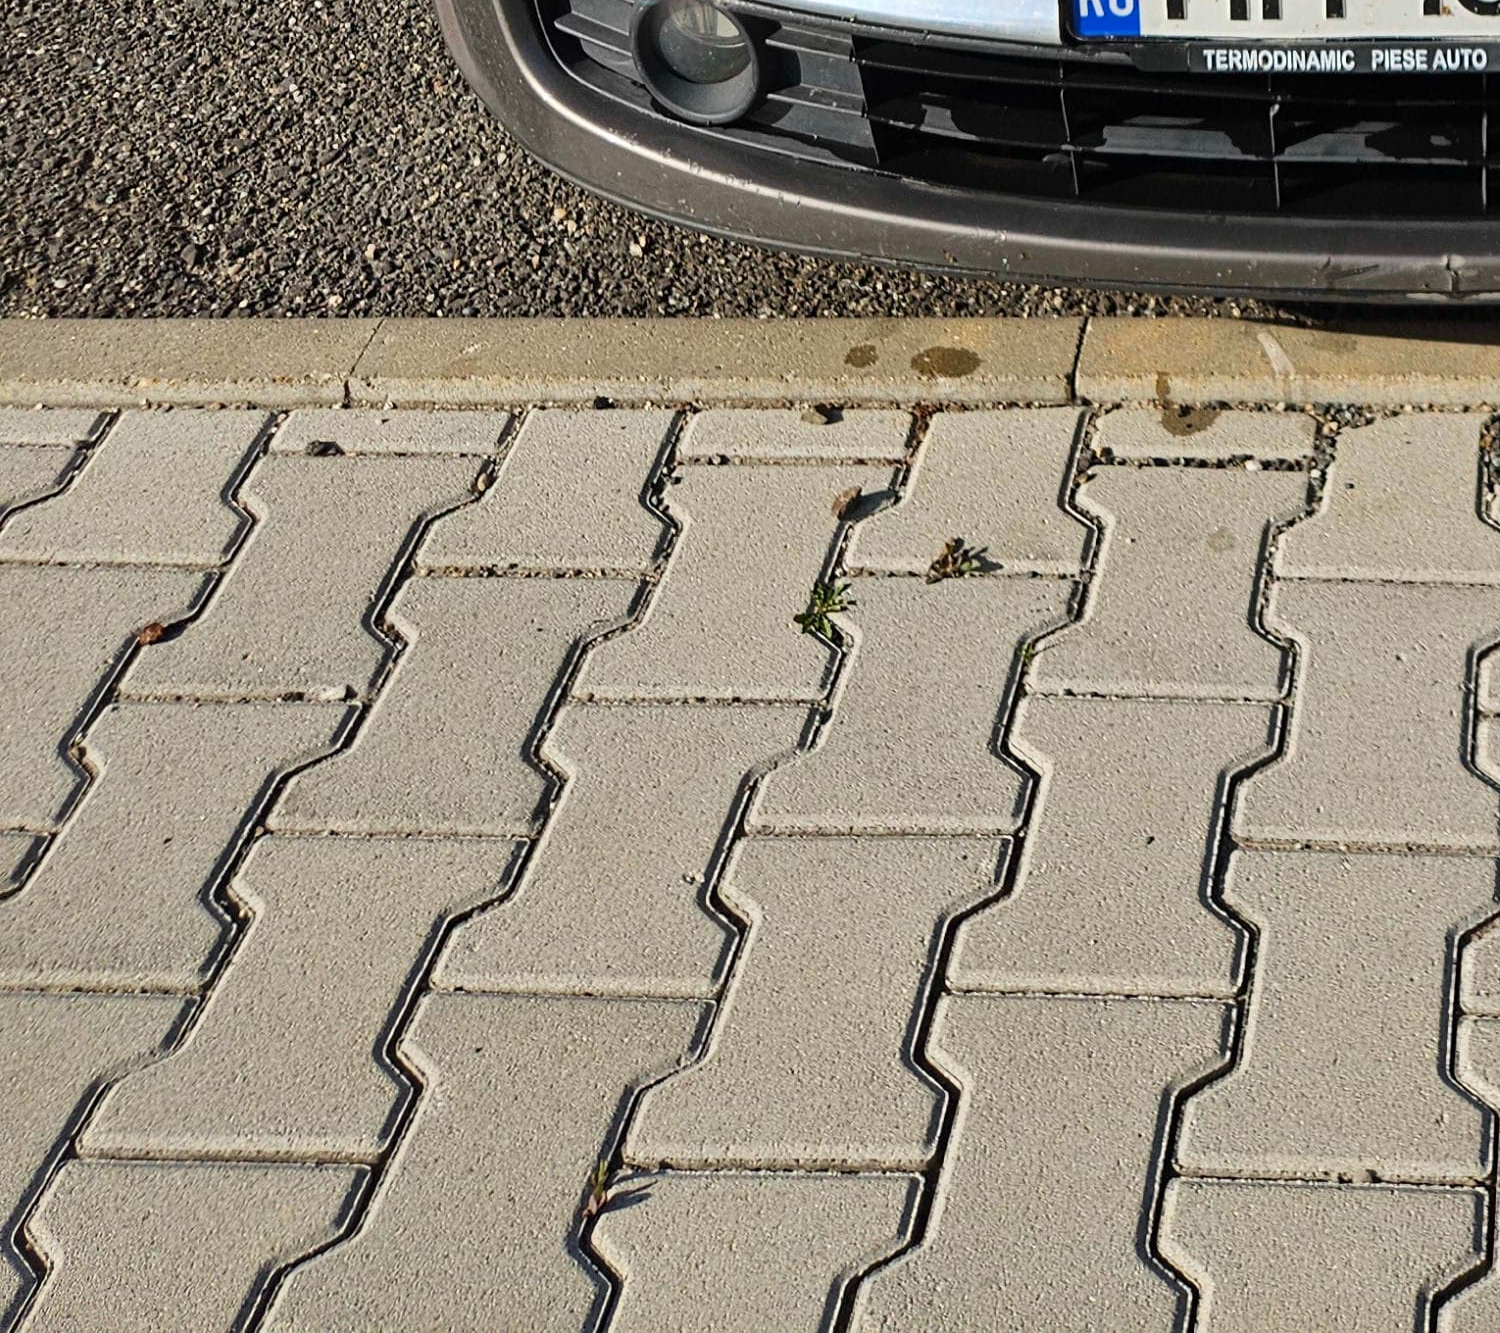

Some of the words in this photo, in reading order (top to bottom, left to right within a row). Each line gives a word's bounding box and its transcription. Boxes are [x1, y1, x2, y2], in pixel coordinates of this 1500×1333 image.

[1203, 48, 1355, 71] TERMODINAMIC
[1371, 48, 1428, 71] PIESE
[1432, 48, 1488, 71] AUTO
